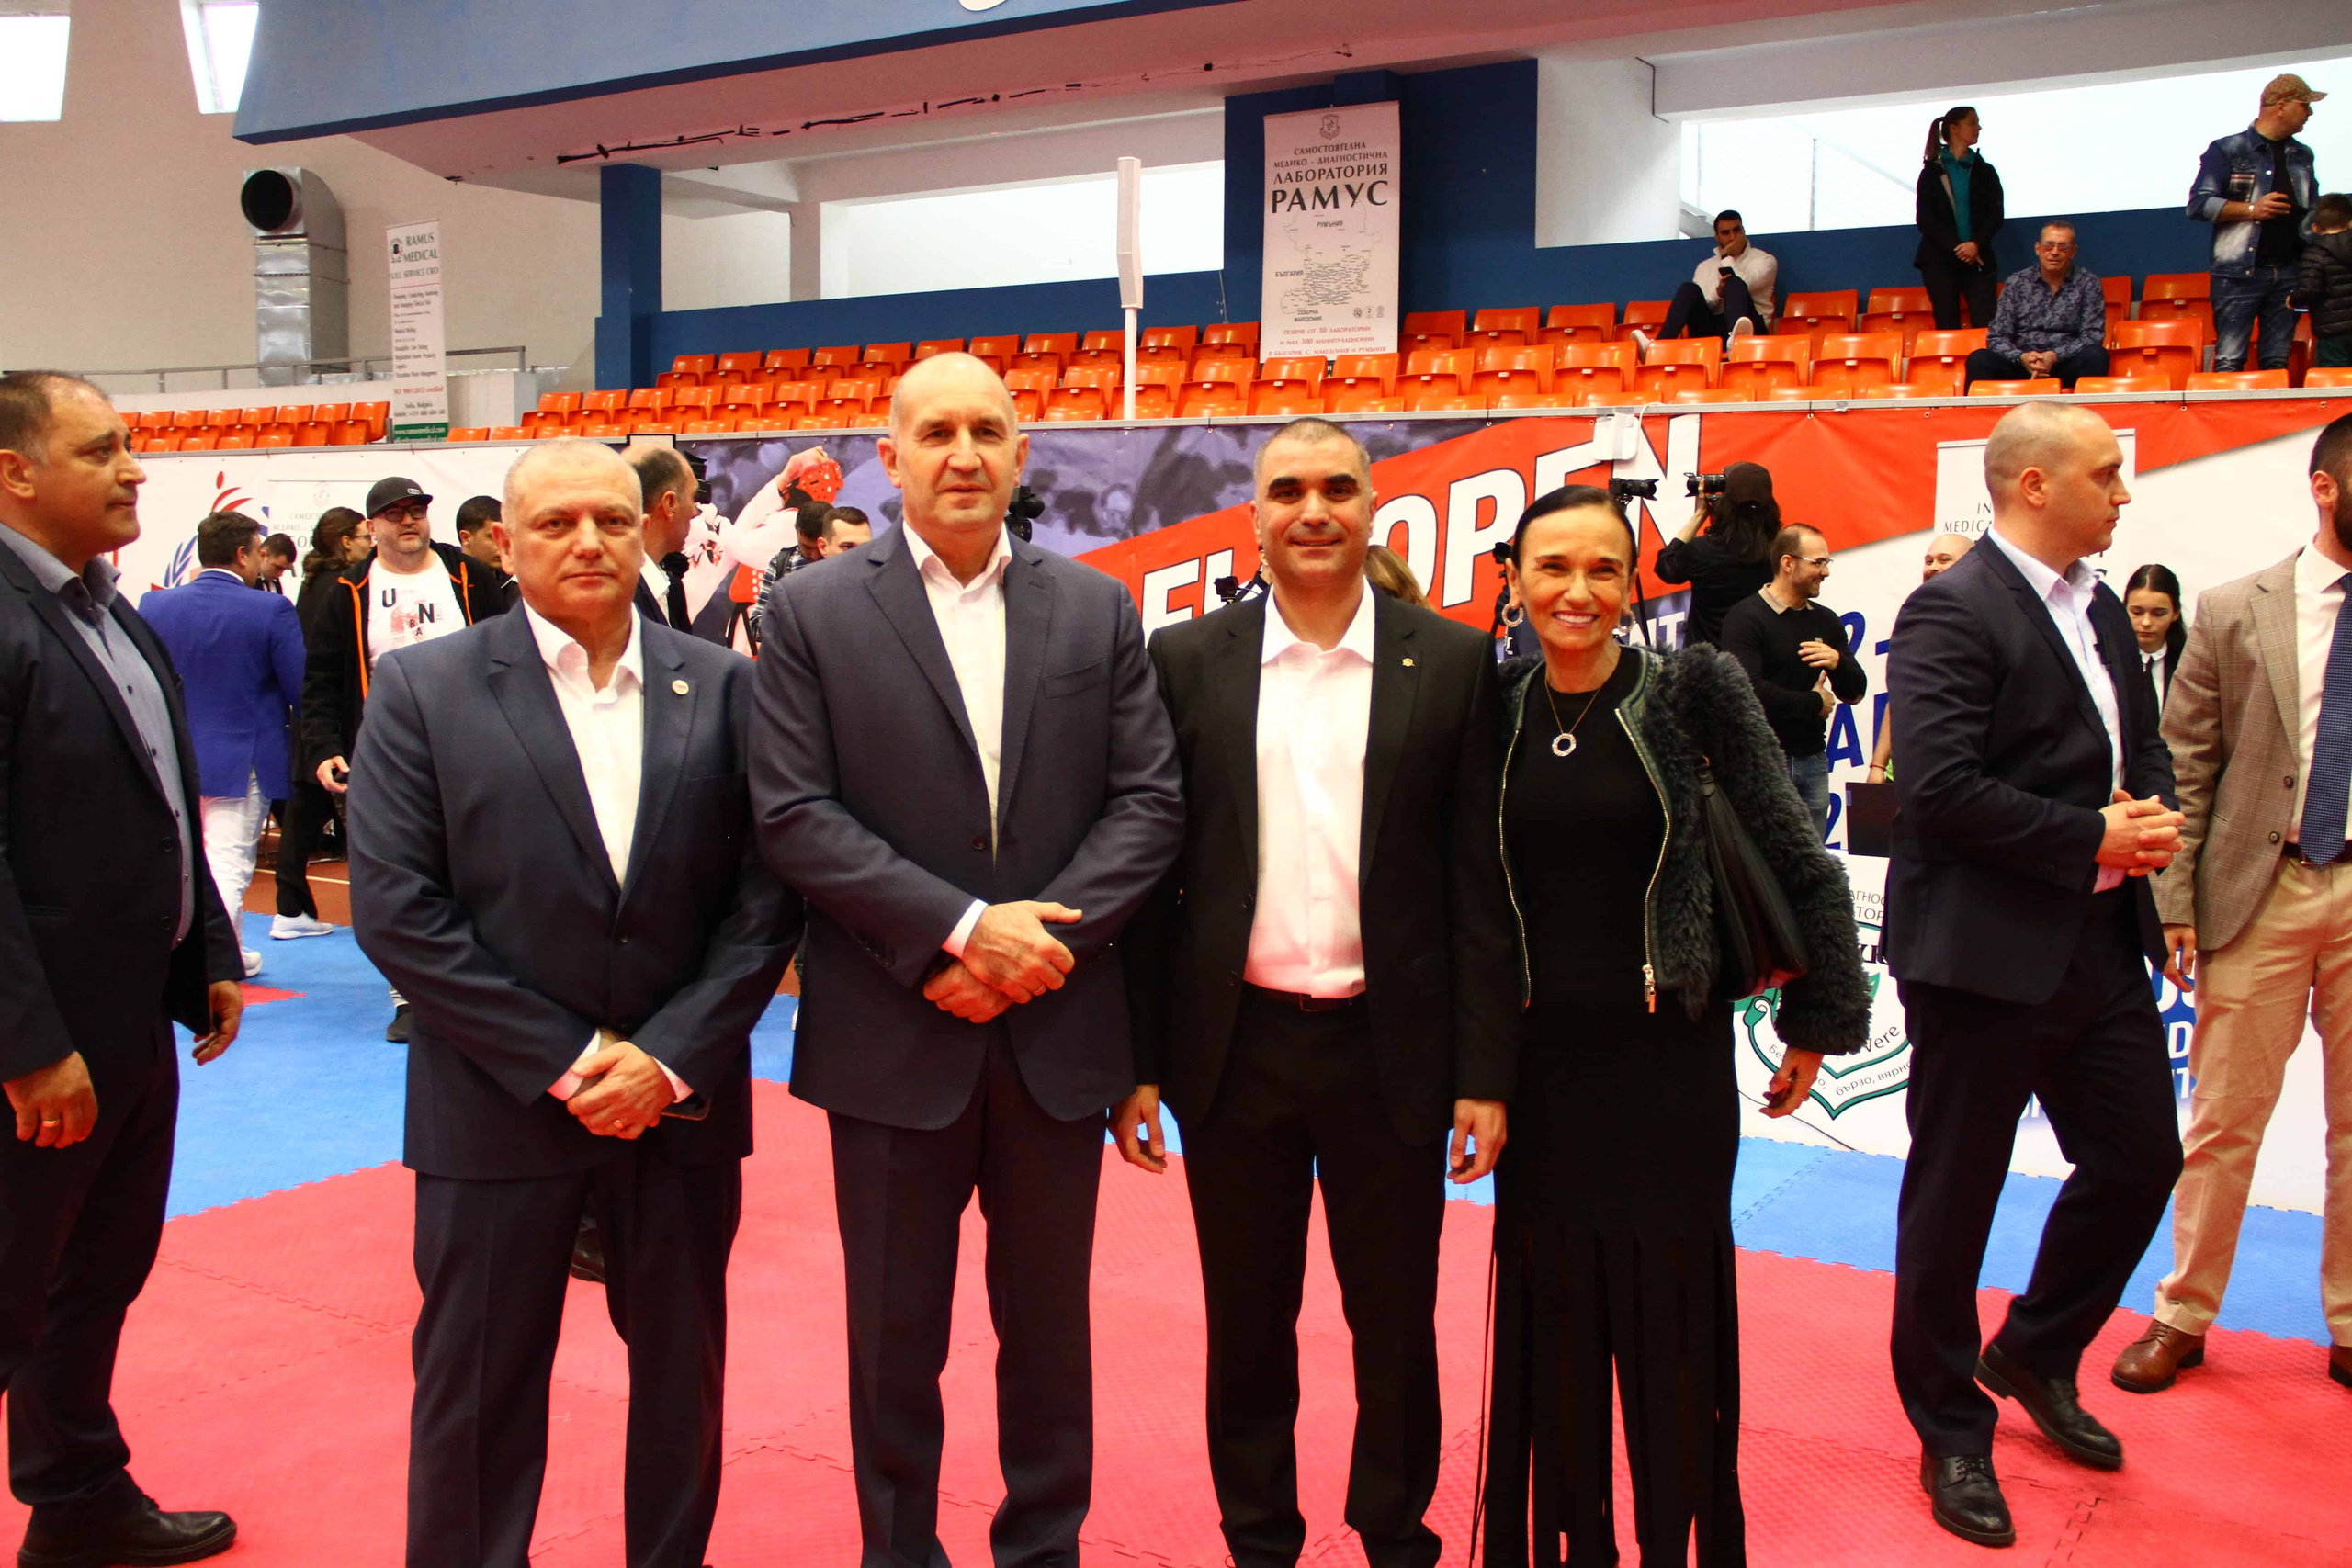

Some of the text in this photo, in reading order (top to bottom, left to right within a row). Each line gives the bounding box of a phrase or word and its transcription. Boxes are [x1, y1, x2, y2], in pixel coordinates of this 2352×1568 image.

[1294, 142, 1366, 155] САМОСТОЯТЕЛНА
[1273, 159, 1307, 168] МЕДИКО
[1317, 152, 1388, 164] ДИАГНОСТИЧНА
[1273, 163, 1388, 185] ЛАБОРАТОРИЯ
[1272, 180, 1388, 213] РАМУС
[406, 232, 434, 246] RAMUS
[404, 249, 439, 263] MEDICAL
